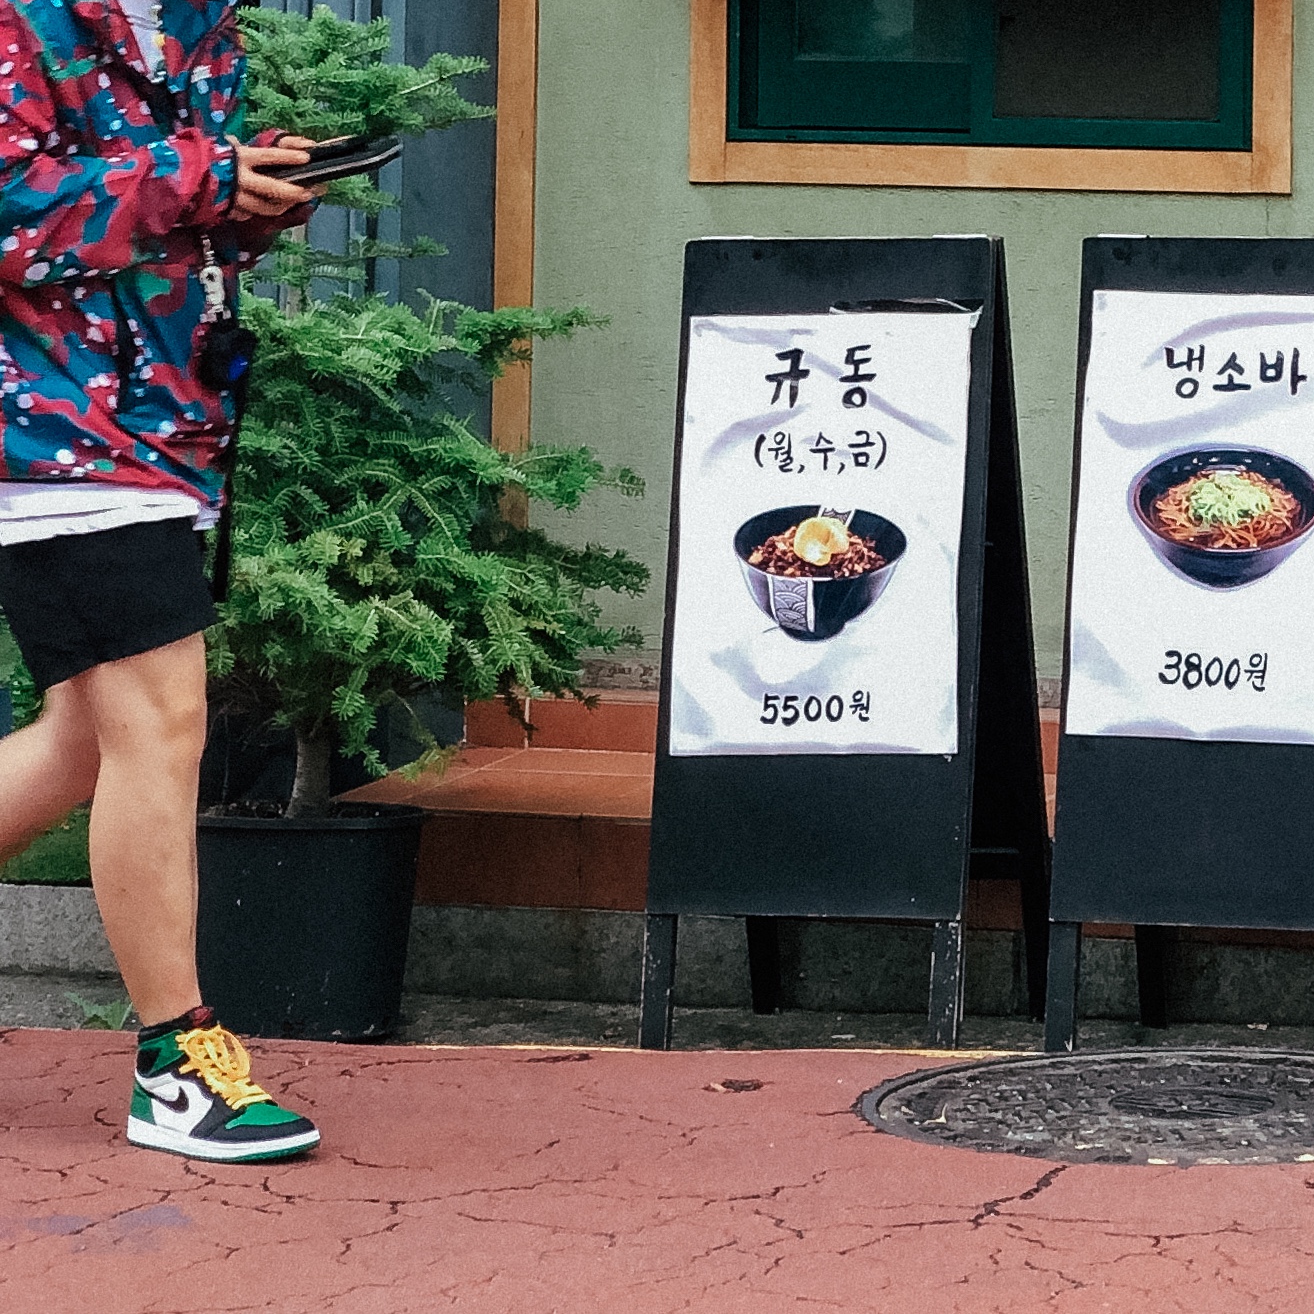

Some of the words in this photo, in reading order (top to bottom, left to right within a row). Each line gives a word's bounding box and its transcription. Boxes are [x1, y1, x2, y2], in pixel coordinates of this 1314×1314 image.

[1164, 344, 1308, 399] 냉소바
[1158, 650, 1268, 692] 3800원
[760, 690, 871, 726] 5500원
